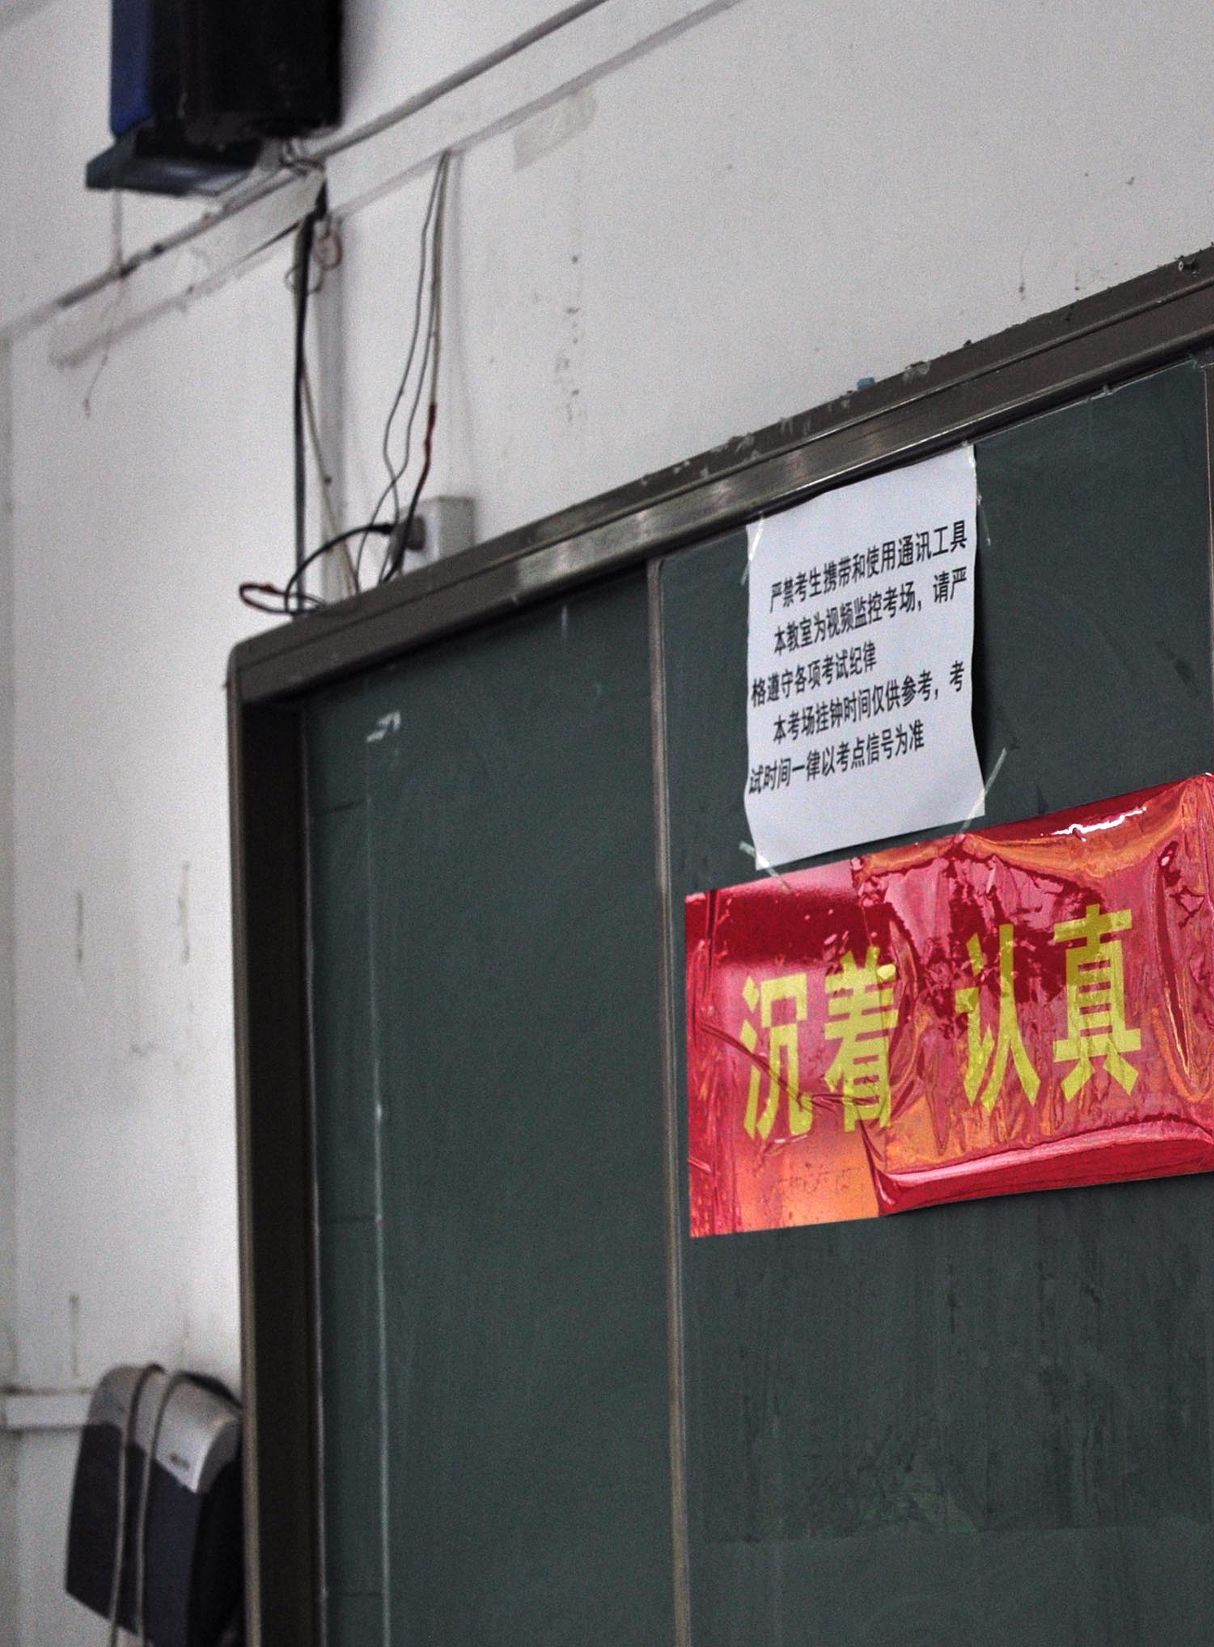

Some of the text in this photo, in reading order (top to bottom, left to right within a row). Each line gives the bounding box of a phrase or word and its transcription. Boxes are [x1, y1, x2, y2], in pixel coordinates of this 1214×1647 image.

[770, 519, 968, 612] 严禁考生携带和使用通讯工具
[750, 641, 877, 708] 格遵守各项考试纪律
[747, 719, 925, 794] 试时间一律以考点信号为准
[740, 946, 898, 1140] 沉着
[955, 903, 1141, 1113] 认真
